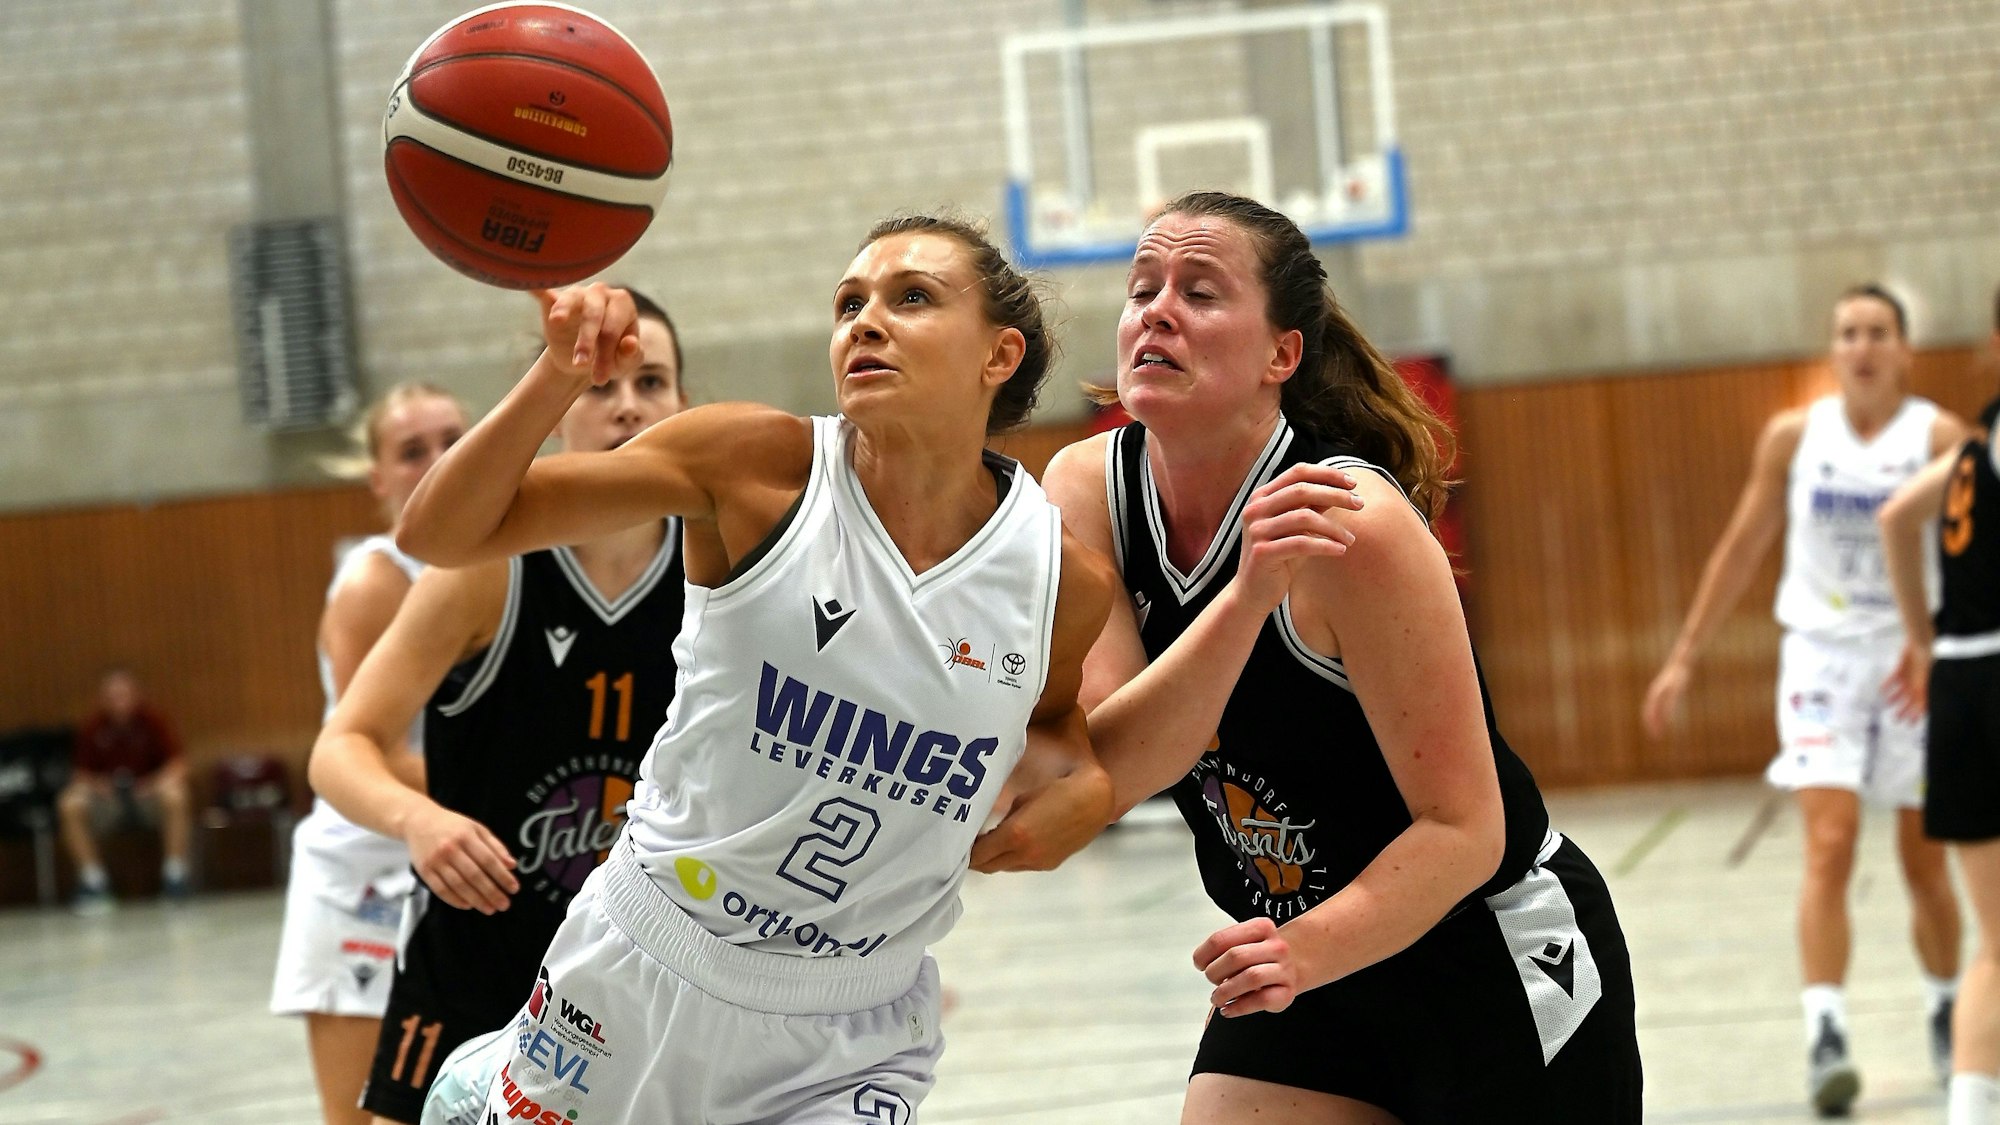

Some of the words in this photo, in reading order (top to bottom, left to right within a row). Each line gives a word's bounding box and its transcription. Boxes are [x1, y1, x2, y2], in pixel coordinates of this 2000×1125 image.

[514, 106, 588, 138] COMPETITION
[507, 156, 564, 185] BG4550
[481, 216, 546, 254] FIBA
[585, 671, 634, 742] 11
[755, 660, 999, 801] WINGS
[750, 732, 971, 823] LEVERKUSEN
[516, 798, 628, 874] Tale
[776, 796, 882, 903] 2
[391, 1014, 444, 1090] 11
[560, 998, 606, 1045] WGL
[526, 1029, 590, 1095] EVL
